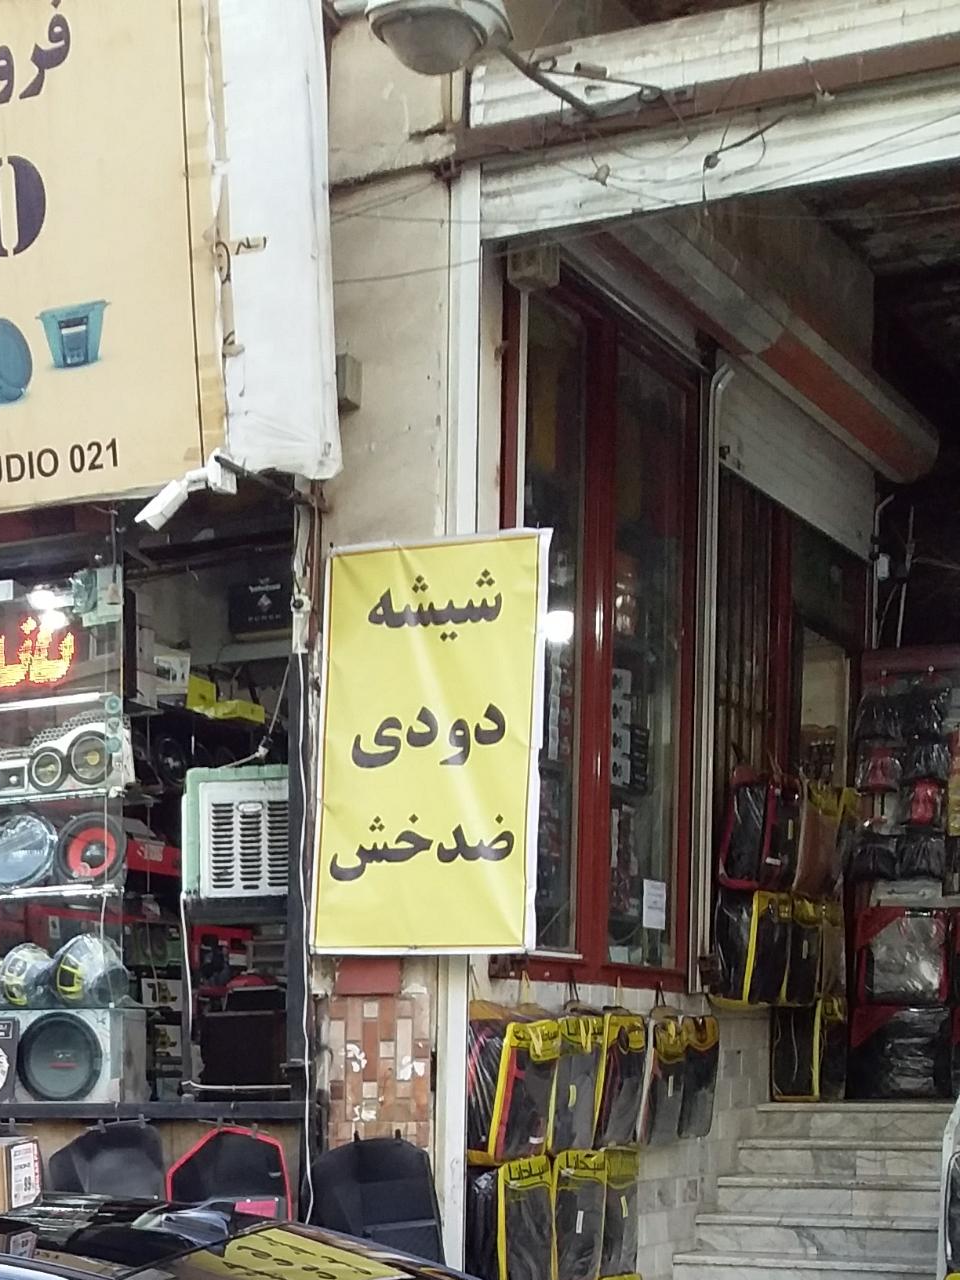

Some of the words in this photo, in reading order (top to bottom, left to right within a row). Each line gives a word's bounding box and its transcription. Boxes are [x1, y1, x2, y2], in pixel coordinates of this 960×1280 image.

[69, 437, 120, 474] 021
[367, 568, 503, 643] شیشه
[351, 703, 506, 768] دودی
